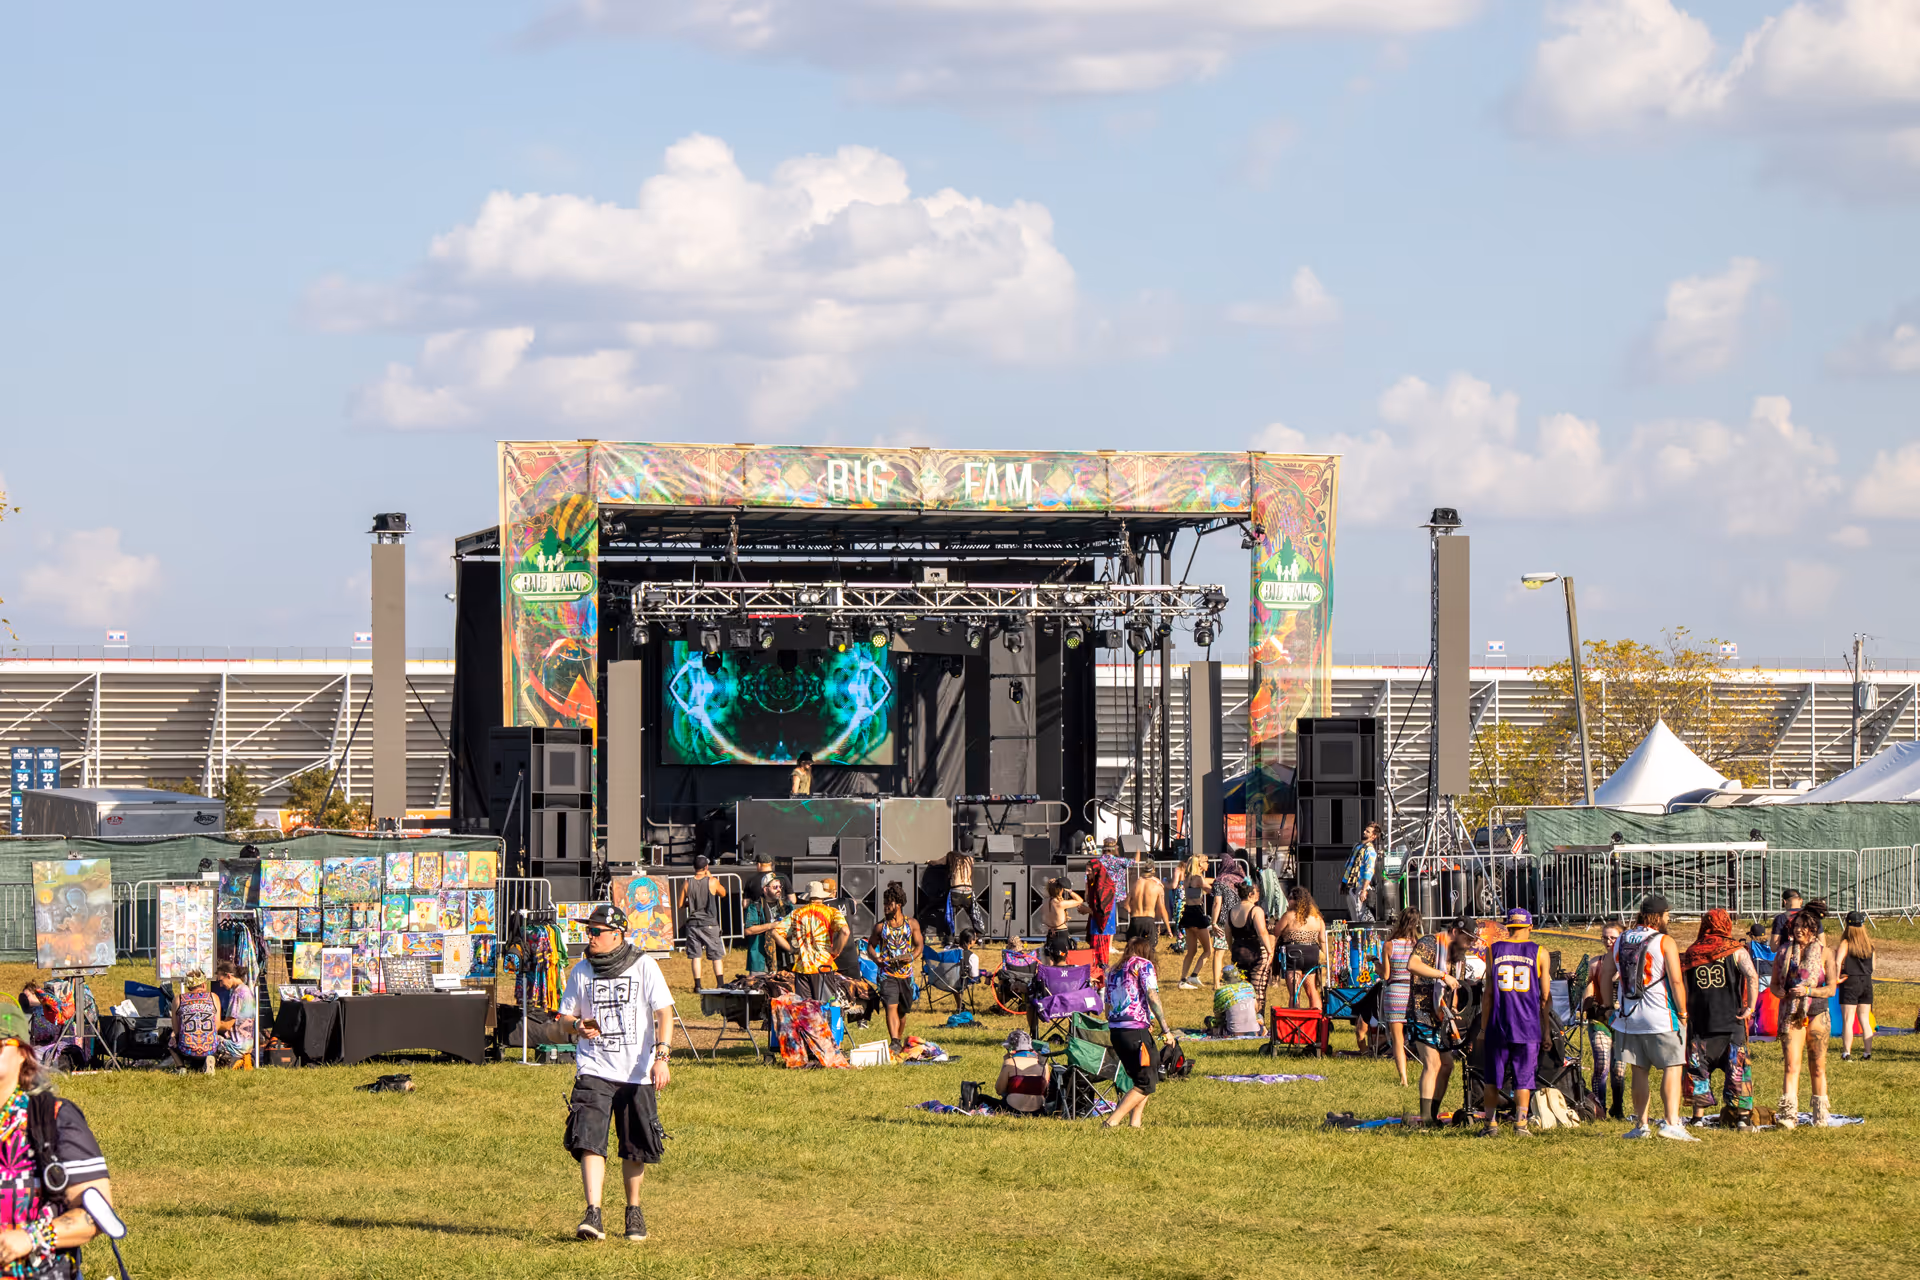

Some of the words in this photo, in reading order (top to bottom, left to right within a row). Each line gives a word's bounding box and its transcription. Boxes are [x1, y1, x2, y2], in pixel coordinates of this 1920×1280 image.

[826, 459, 889, 502] BIG
[964, 462, 1033, 504] FAM
[520, 574, 548, 593] BIG
[552, 573, 582, 592] FAM
[20, 760, 26, 769] 2
[43, 760, 54, 769] 19
[17, 773, 29, 782] 56
[42, 773, 54, 782] 23
[1498, 964, 1531, 993] 33
[1696, 965, 1726, 990] 93
[183, 1012, 214, 1034] 33
